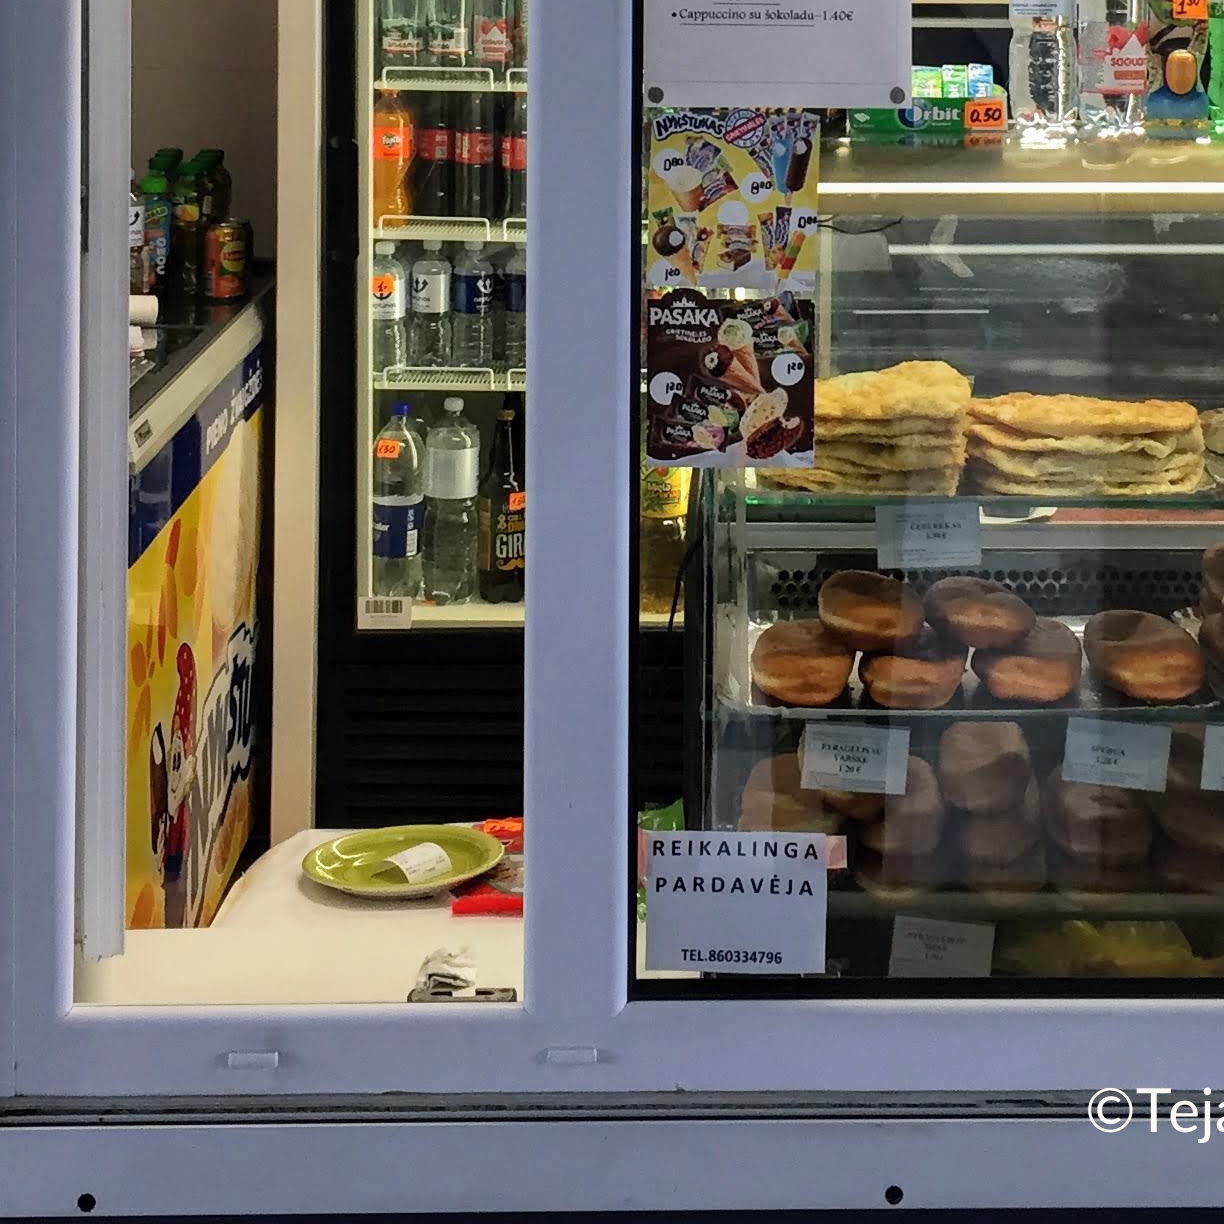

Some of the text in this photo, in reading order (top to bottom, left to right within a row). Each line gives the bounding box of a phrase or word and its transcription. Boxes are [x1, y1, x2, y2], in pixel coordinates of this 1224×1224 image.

[679, 8, 746, 21] Cappuccino
[749, 10, 761, 20] su
[650, 306, 721, 327] PASAKA
[495, 533, 525, 558] GIR
[652, 839, 819, 860] REIKALINGA
[654, 874, 814, 897] PARDAVĖJA
[681, 948, 783, 965] TEL.860334796
